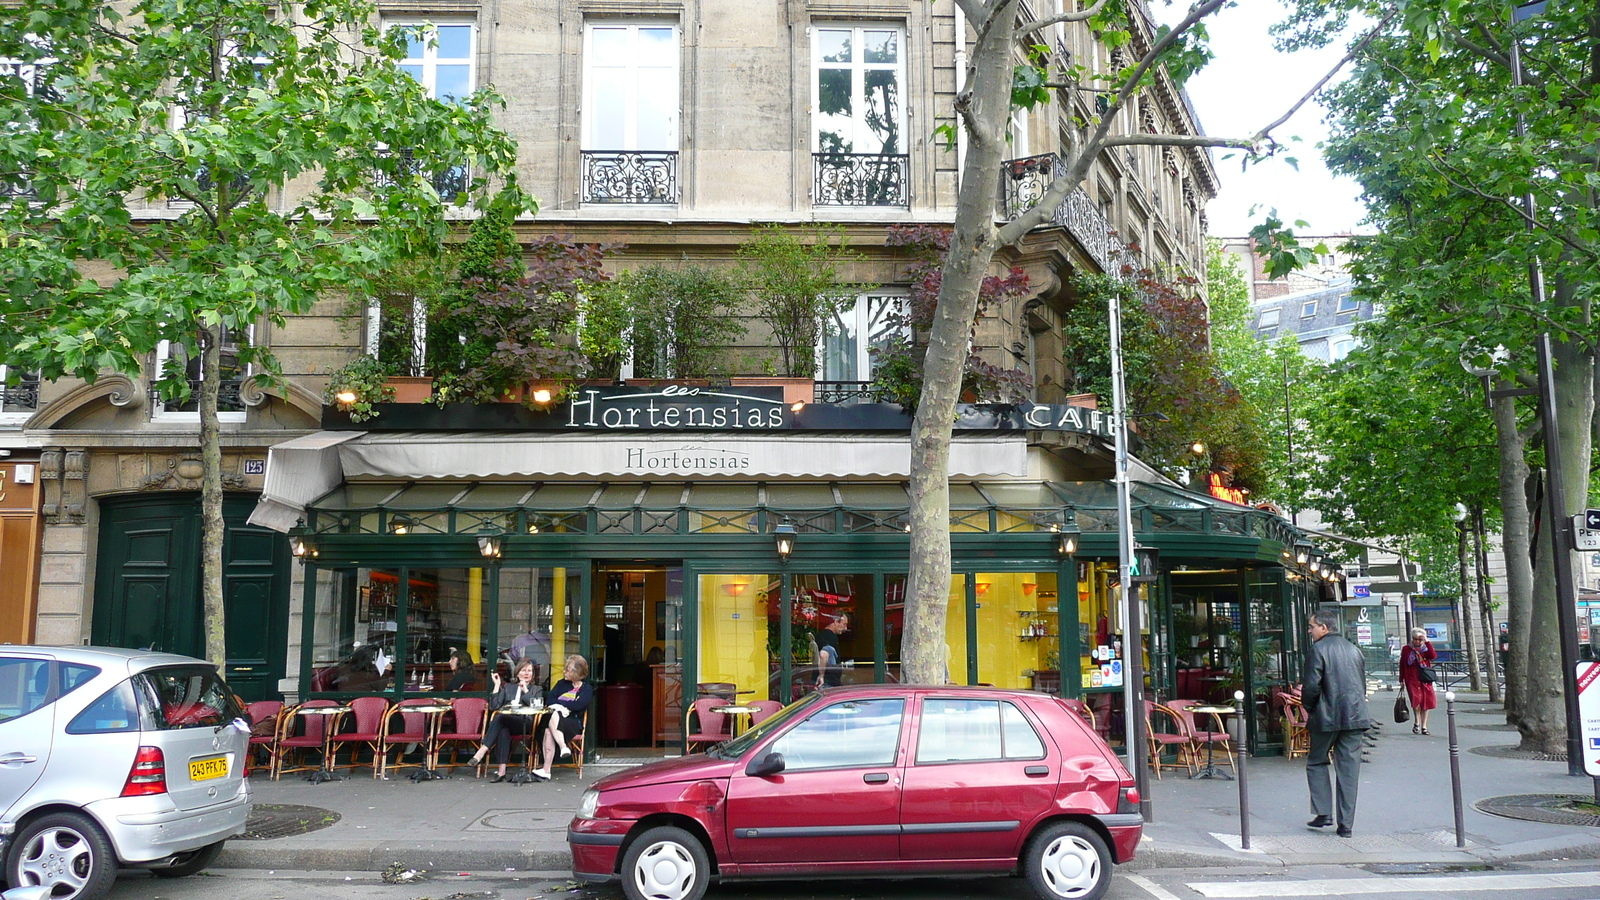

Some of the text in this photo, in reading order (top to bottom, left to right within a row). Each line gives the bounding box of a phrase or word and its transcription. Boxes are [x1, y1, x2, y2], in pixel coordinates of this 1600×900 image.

[565, 389, 783, 429] Hortensias
[245, 460, 263, 473] 123
[625, 448, 749, 469] Hortensias
[191, 759, 227, 776] 243 PFK 75
